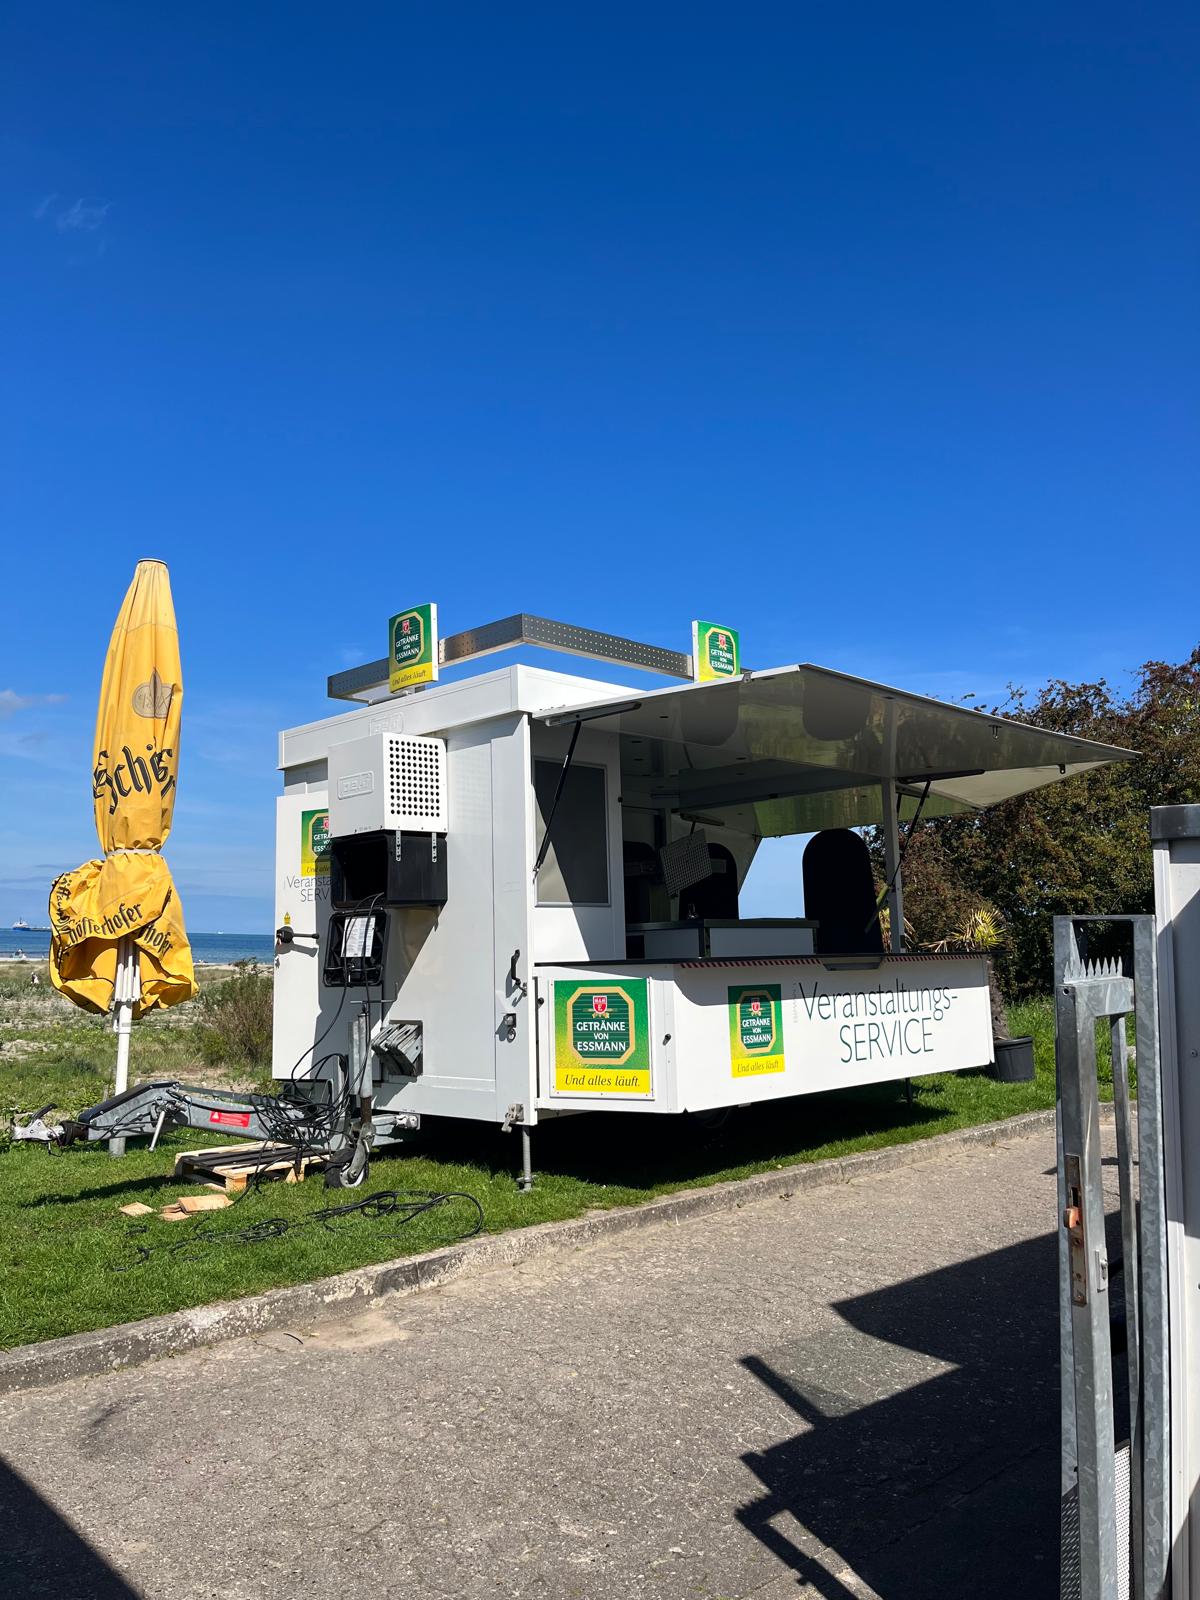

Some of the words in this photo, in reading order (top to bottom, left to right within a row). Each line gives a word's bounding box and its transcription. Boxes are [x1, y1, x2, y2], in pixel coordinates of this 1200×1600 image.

[396, 633, 419, 648] GETRÄNKE
[396, 647, 420, 660] ESSMANN
[711, 649, 733, 659] GETRÄNKE
[711, 660, 734, 671] ESSMANN
[287, 875, 332, 888] Veransta
[300, 888, 331, 902] SERV
[799, 978, 958, 1021] Veranstaltungs-
[576, 1020, 626, 1031] GETRÄNKE
[742, 1017, 771, 1028] GETRÄNKE
[594, 1032, 609, 1040] VON
[743, 1033, 772, 1044] ESSMANN
[840, 1017, 934, 1064] SERVICE
[577, 1041, 626, 1052] ESSMANN
[737, 1063, 749, 1073] Und
[751, 1062, 765, 1072] alles
[565, 1074, 585, 1086] Und
[587, 1075, 612, 1086] alles
[615, 1075, 640, 1087] läuft.
